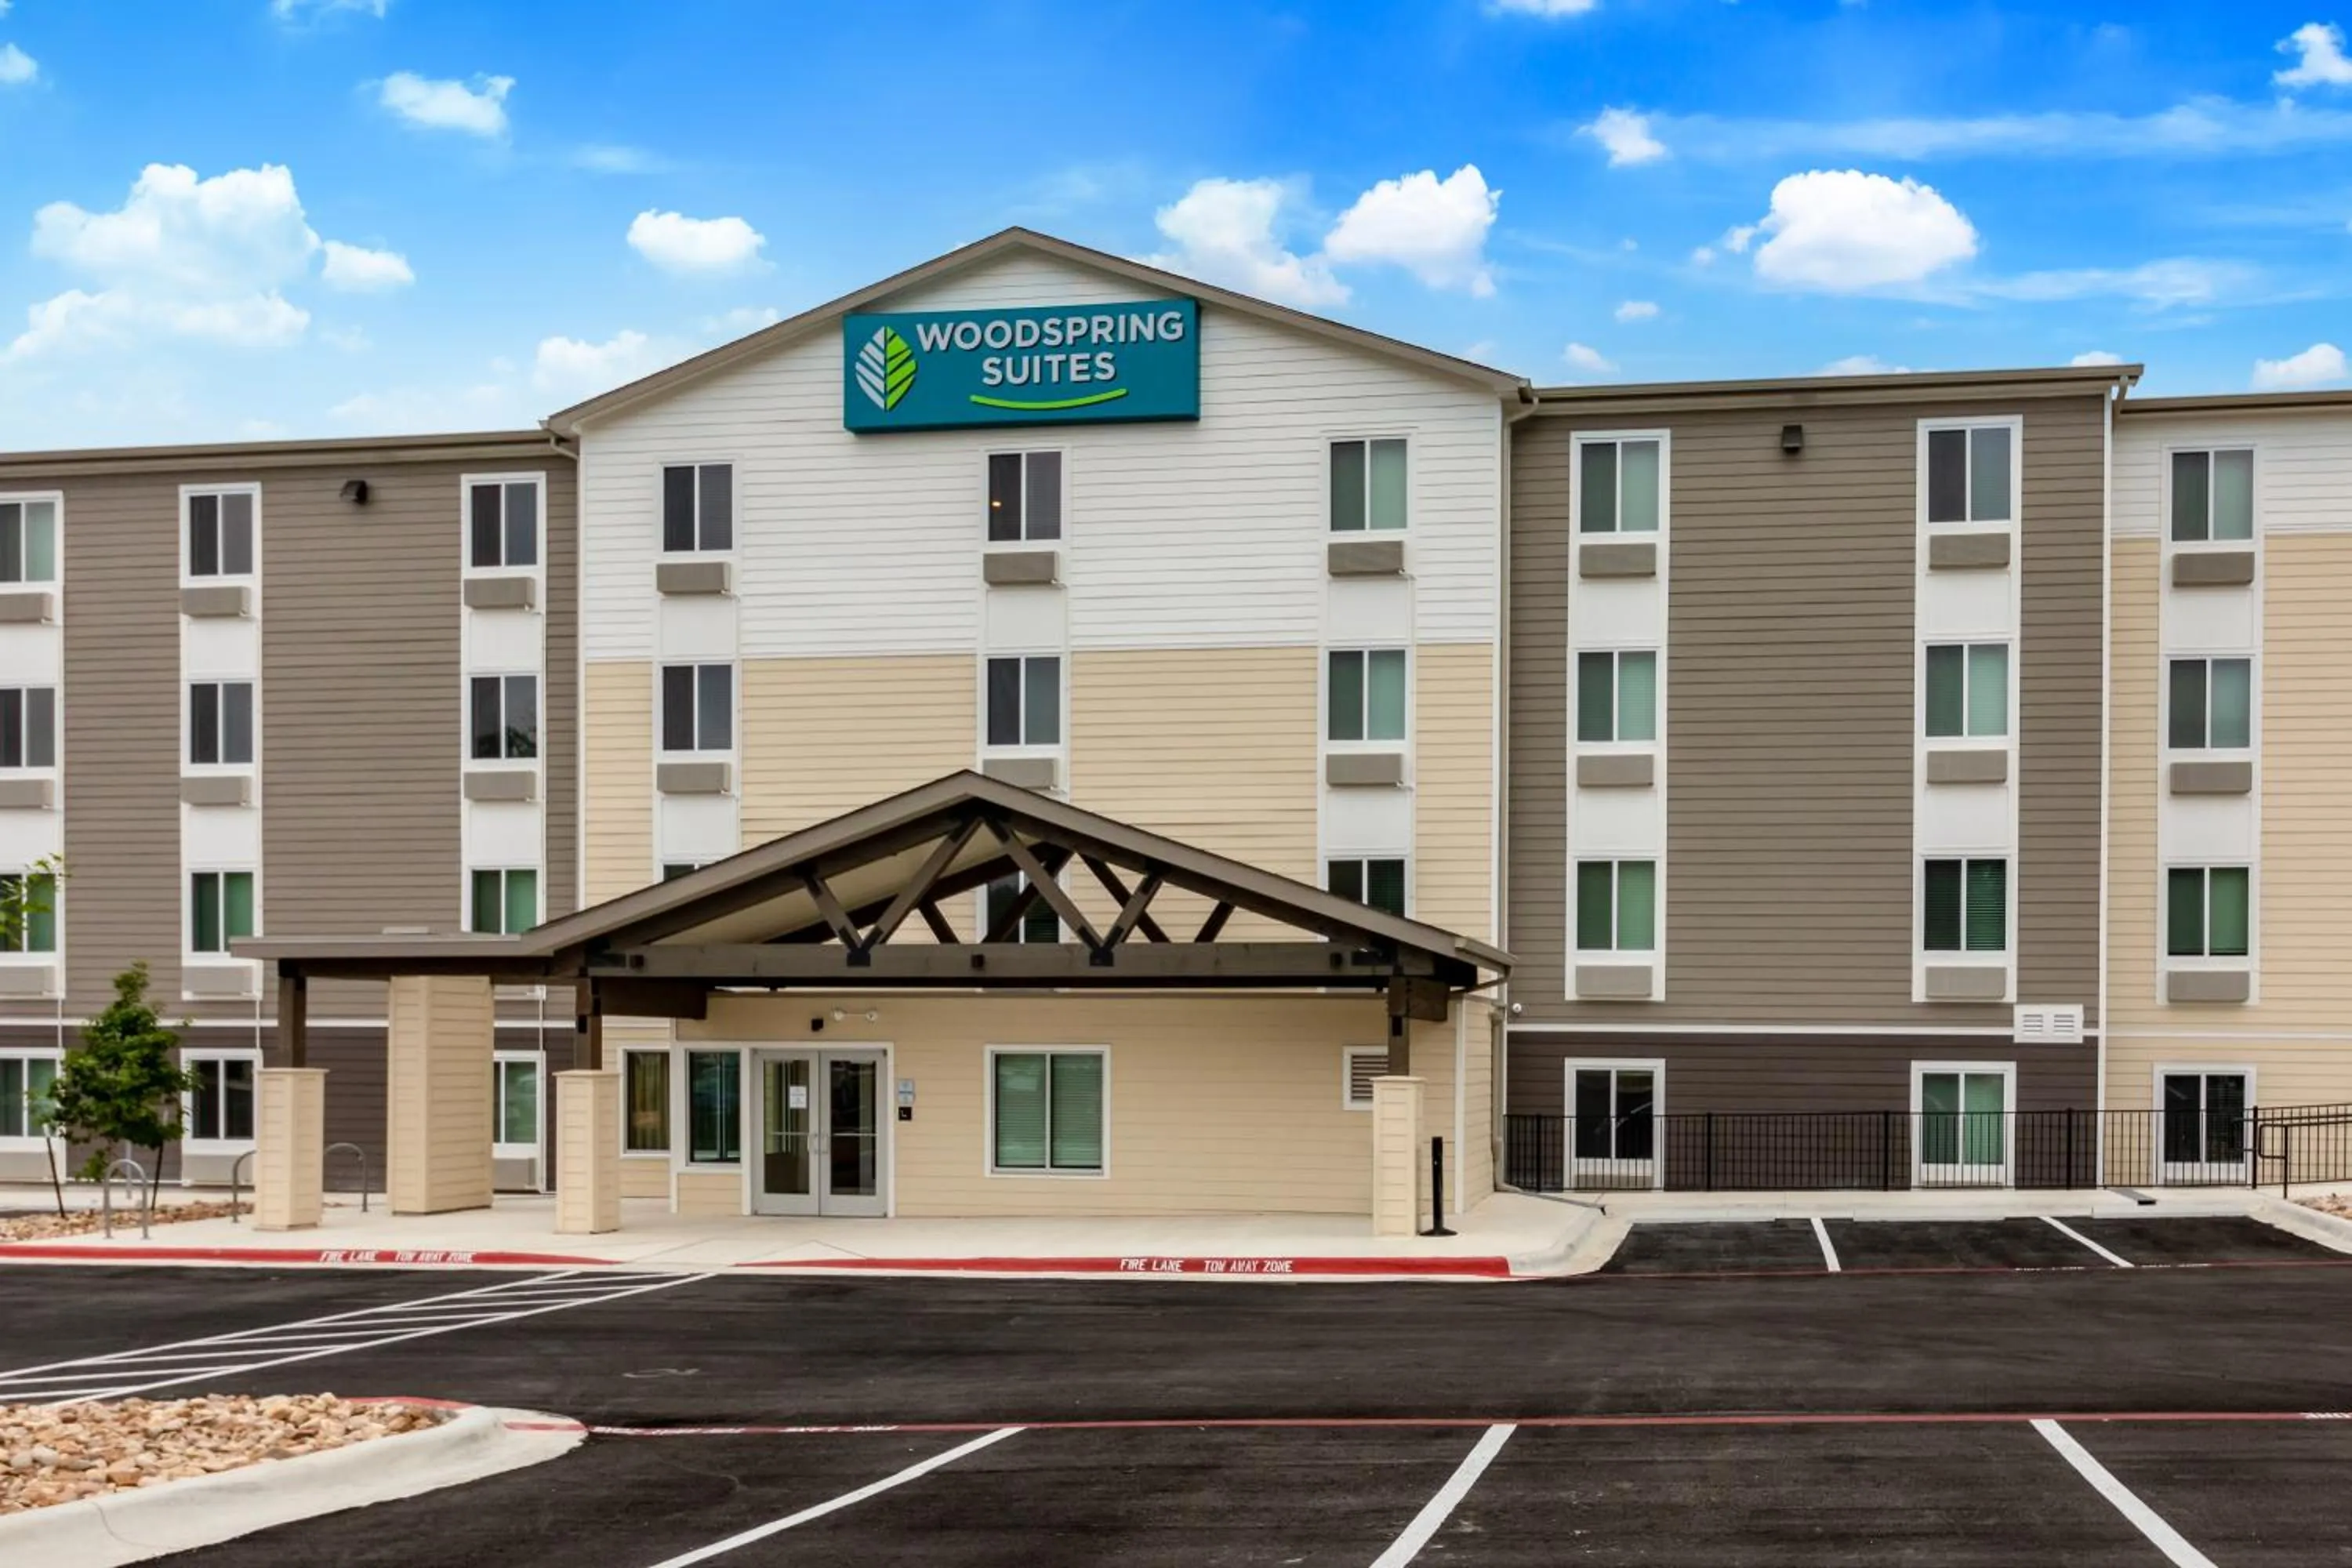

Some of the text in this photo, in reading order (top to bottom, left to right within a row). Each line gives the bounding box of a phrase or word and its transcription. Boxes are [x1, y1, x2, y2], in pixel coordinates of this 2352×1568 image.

[916, 311, 1185, 352] WOODSPRING
[982, 351, 1116, 385] SUITES
[1120, 1258, 1293, 1272] FIRE LANE TOW AWAY ZONE
